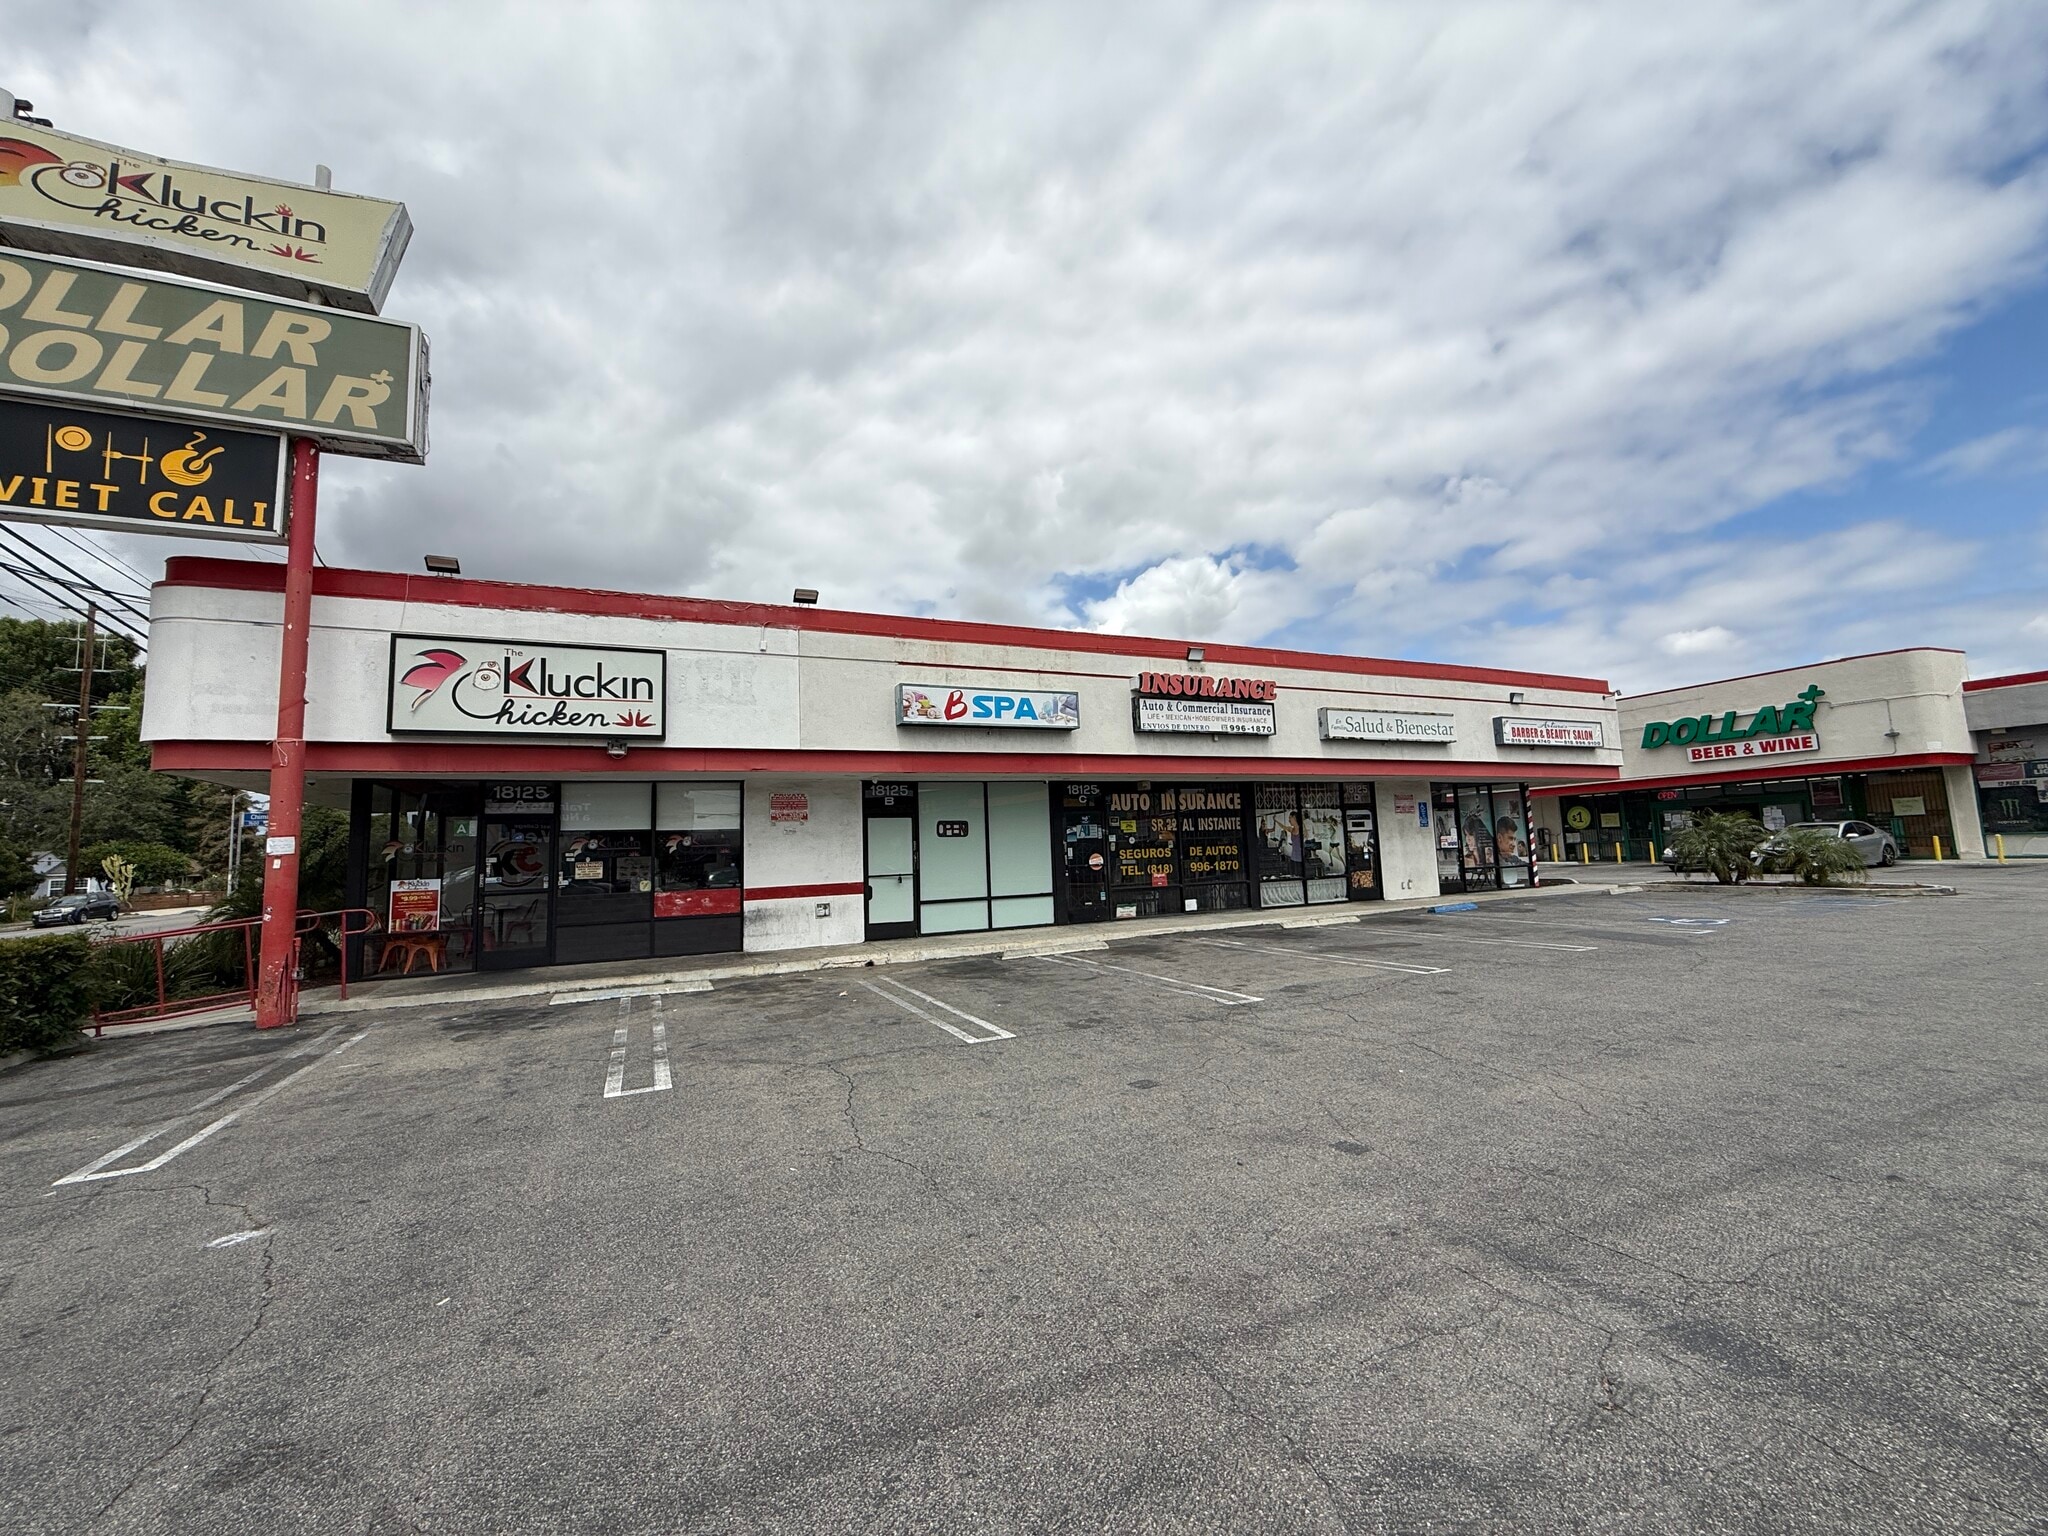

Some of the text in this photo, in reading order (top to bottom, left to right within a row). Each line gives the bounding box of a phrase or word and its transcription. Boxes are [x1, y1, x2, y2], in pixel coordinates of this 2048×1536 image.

[114, 157, 141, 170] The
[31, 166, 260, 251] Chicken
[107, 163, 328, 244] Kluckin
[0, 322, 392, 430] OLLAR
[149, 491, 268, 528] CALI
[504, 648, 523, 657] The
[503, 656, 653, 699] Kluckin
[1139, 672, 1277, 700] INSURANCE
[452, 671, 610, 727] Chicken
[944, 689, 1038, 721] B SPA
[1141, 700, 1271, 716] Auto & Commercial Insurance
[1195, 715, 1235, 723] HOMEOWNERS
[1236, 716, 1267, 724] INSURANCE
[1345, 715, 1454, 736] Salud & Bienestar
[1640, 699, 1818, 749] DOLLAR
[1229, 725, 1272, 733] 996-1870
[1511, 727, 1594, 741] BARBER & BEAUTY SALON
[1691, 736, 1814, 760] BEER & WINE
[493, 785, 549, 799] 18125
[870, 785, 909, 796] 18125
[1067, 784, 1099, 795] 18125
[1346, 784, 1368, 793] 18125
[1657, 791, 1678, 800] OPEN
[884, 797, 895, 806] B
[1078, 795, 1087, 804] C
[1110, 793, 1150, 811] AUTO
[1182, 819, 1194, 831] AL
[1198, 817, 1241, 831] INSTANTE
[1571, 811, 1584, 823] $1
[456, 824, 467, 833] A
[1119, 845, 1238, 860] SEGUROS DE AUTOS
[1120, 860, 1239, 876] TEL. (818) 996-1870
